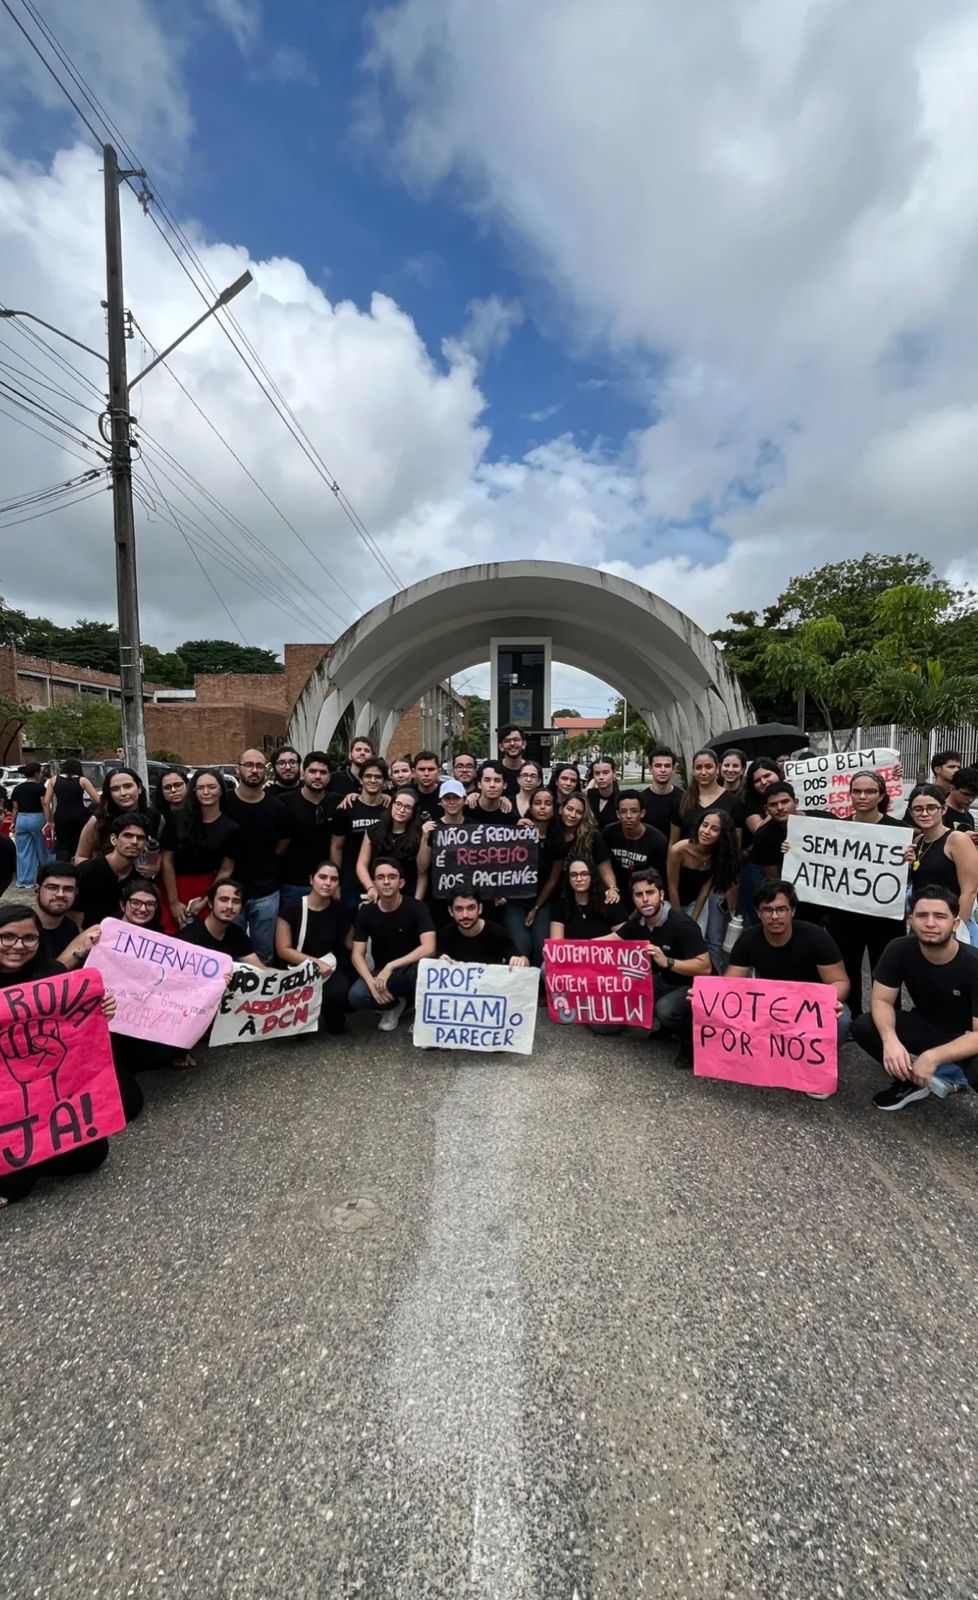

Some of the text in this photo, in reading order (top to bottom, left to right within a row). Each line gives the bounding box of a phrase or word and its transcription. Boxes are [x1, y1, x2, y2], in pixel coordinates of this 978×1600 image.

[785, 749, 876, 777] PELO BEM
[803, 776, 827, 792] DOS
[805, 794, 827, 807] DOS
[436, 826, 468, 847] NÃO
[471, 824, 484, 844] É
[435, 846, 528, 867] É RESPEITO
[802, 835, 906, 867] SEM MAIS
[438, 865, 538, 891] AOS PACIENTES
[792, 862, 901, 905] ATRASO
[112, 931, 219, 978] INTERNATO
[543, 944, 651, 972] VOTEM POR NÓS
[261, 973, 278, 995] É
[546, 973, 632, 993] VOTEM PELO
[220, 993, 234, 1015] É
[427, 998, 500, 1026] LEIAM
[576, 995, 644, 1022] HULW
[699, 990, 824, 1029] VOTEM
[238, 1003, 309, 1037] À DCN
[436, 1027, 514, 1047] PARECER
[700, 1025, 826, 1065] POR NÓS
[0, 1092, 98, 1168] JÁ!
